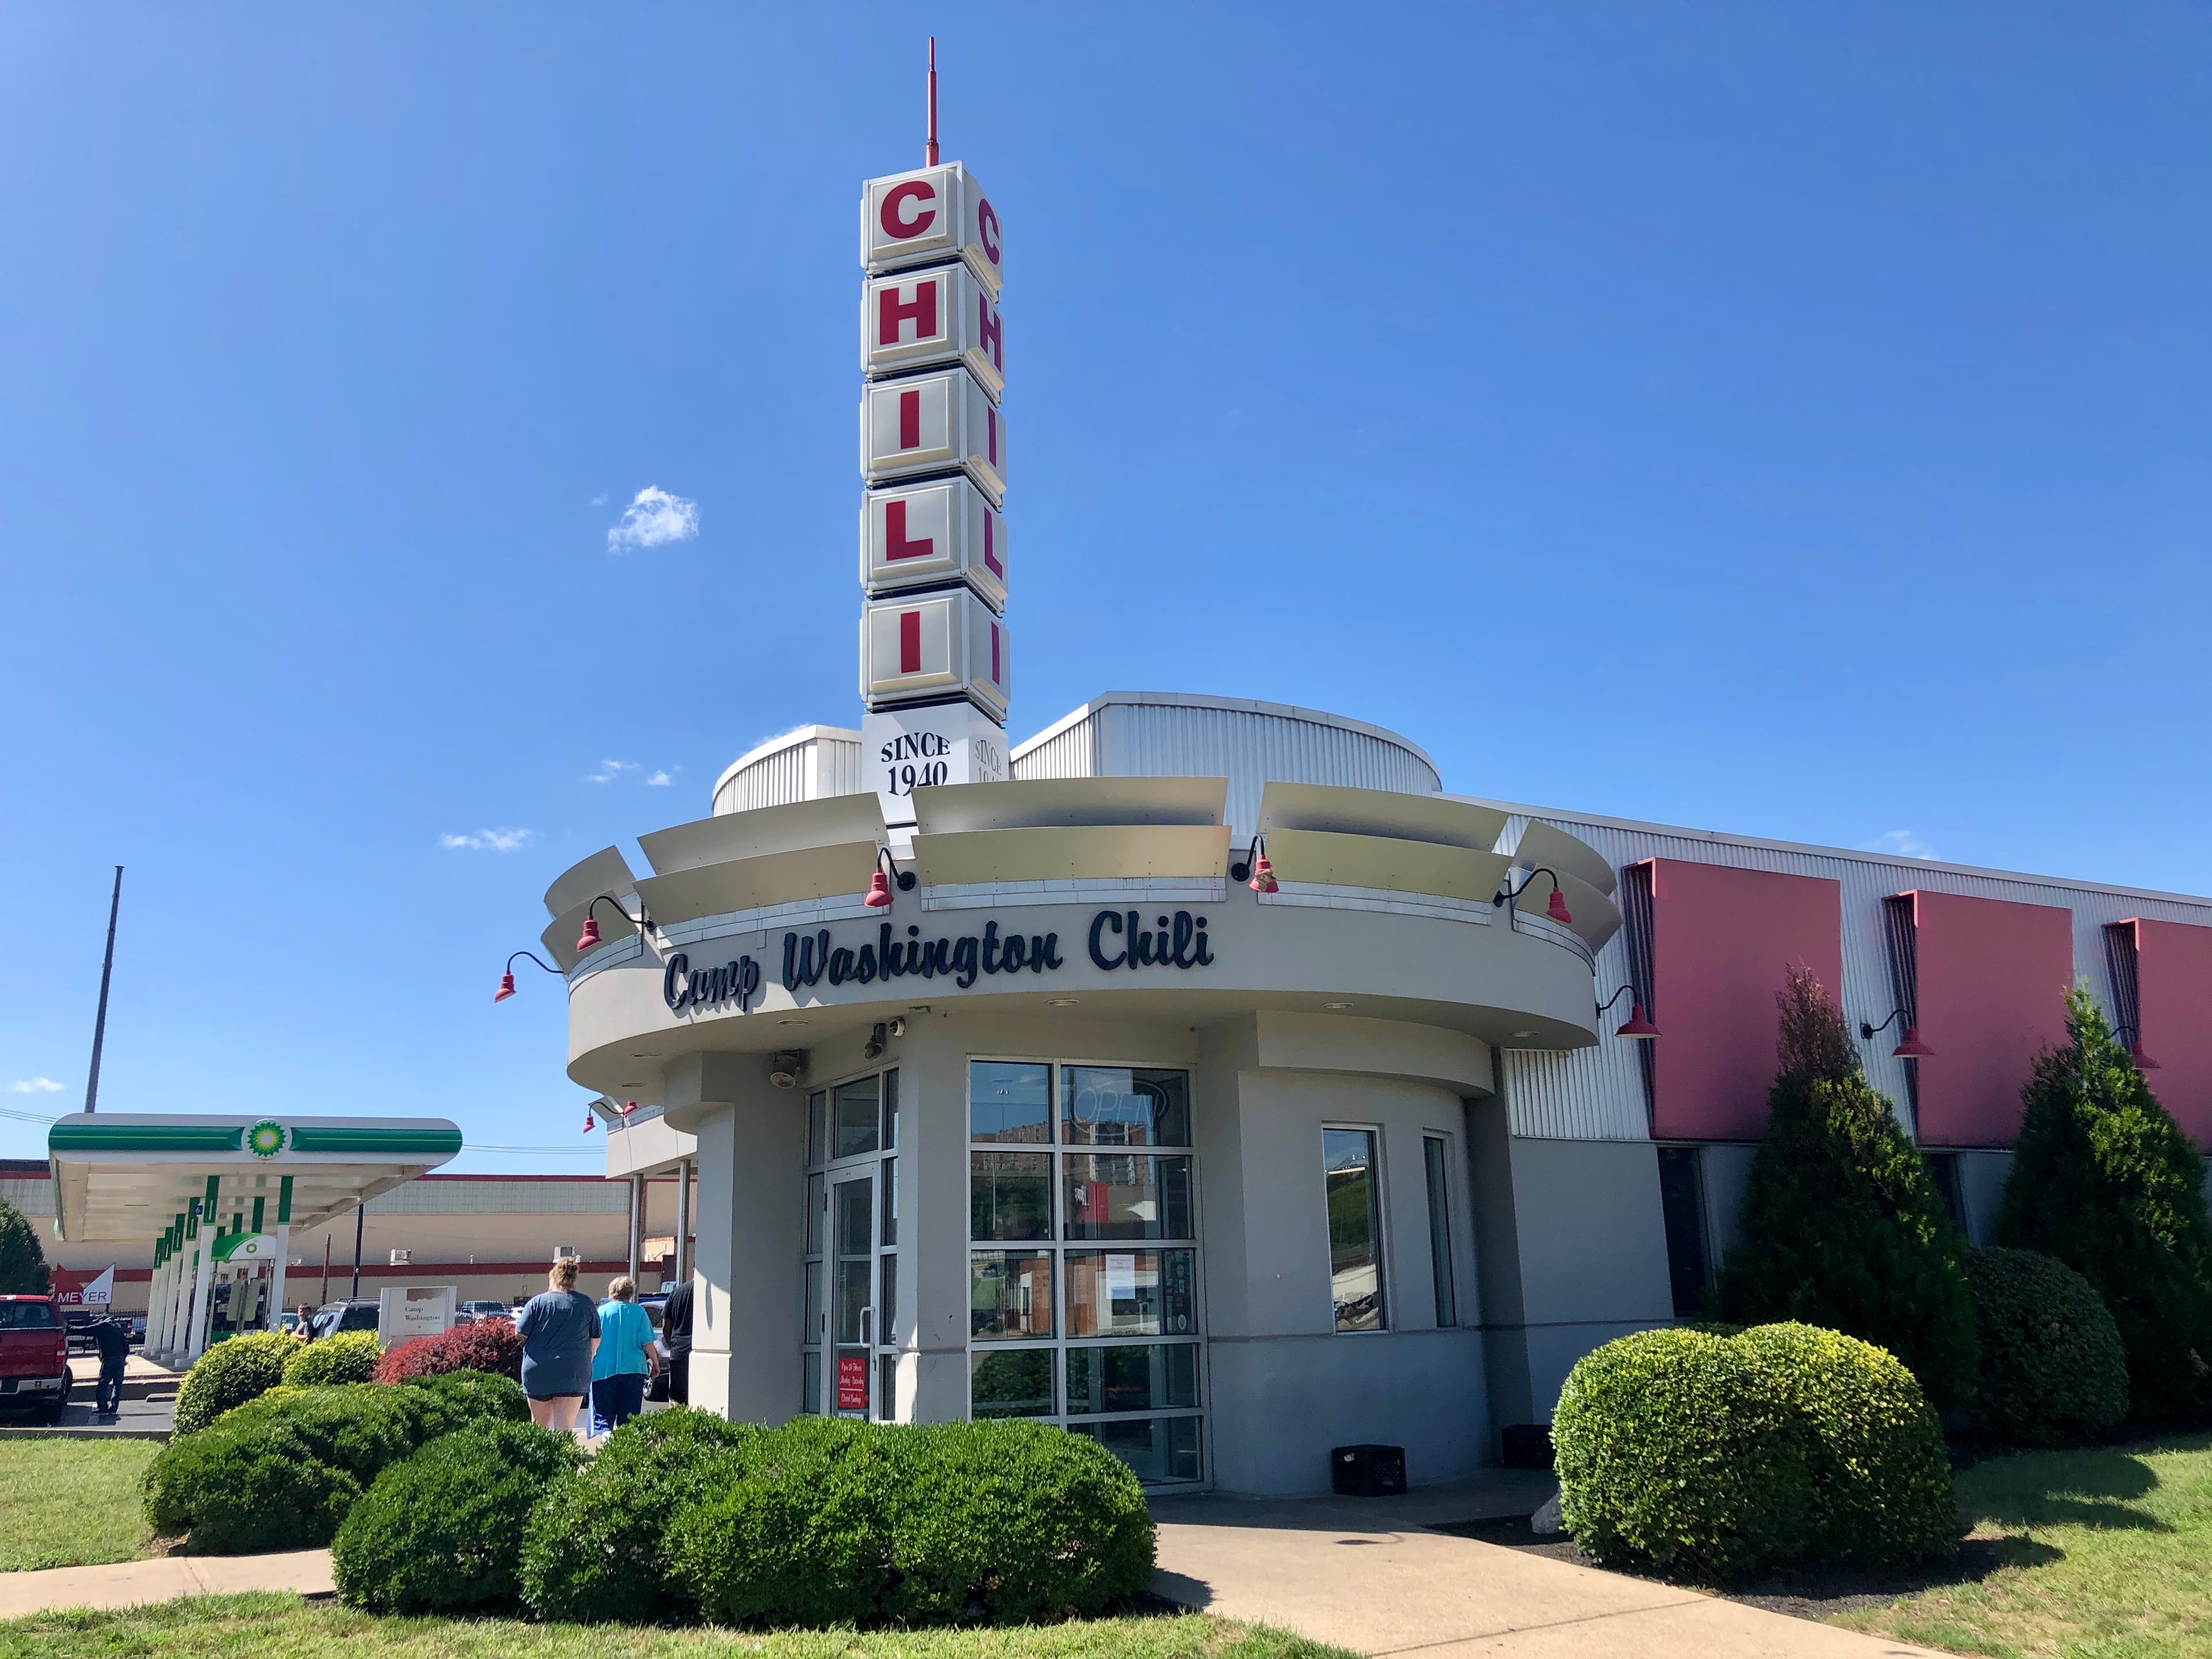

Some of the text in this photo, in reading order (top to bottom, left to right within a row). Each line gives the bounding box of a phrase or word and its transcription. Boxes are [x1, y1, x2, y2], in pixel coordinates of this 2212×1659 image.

[880, 180, 937, 674] CHILI
[978, 198, 1003, 686] CHILI
[881, 732, 950, 763] SINCE
[975, 739, 1002, 777] SINCE
[888, 761, 948, 797] 1940
[664, 910, 1214, 1012] Camp Washington Chili
[1074, 1088, 1159, 1127] OPEN
[58, 1291, 108, 1303] MEYER
